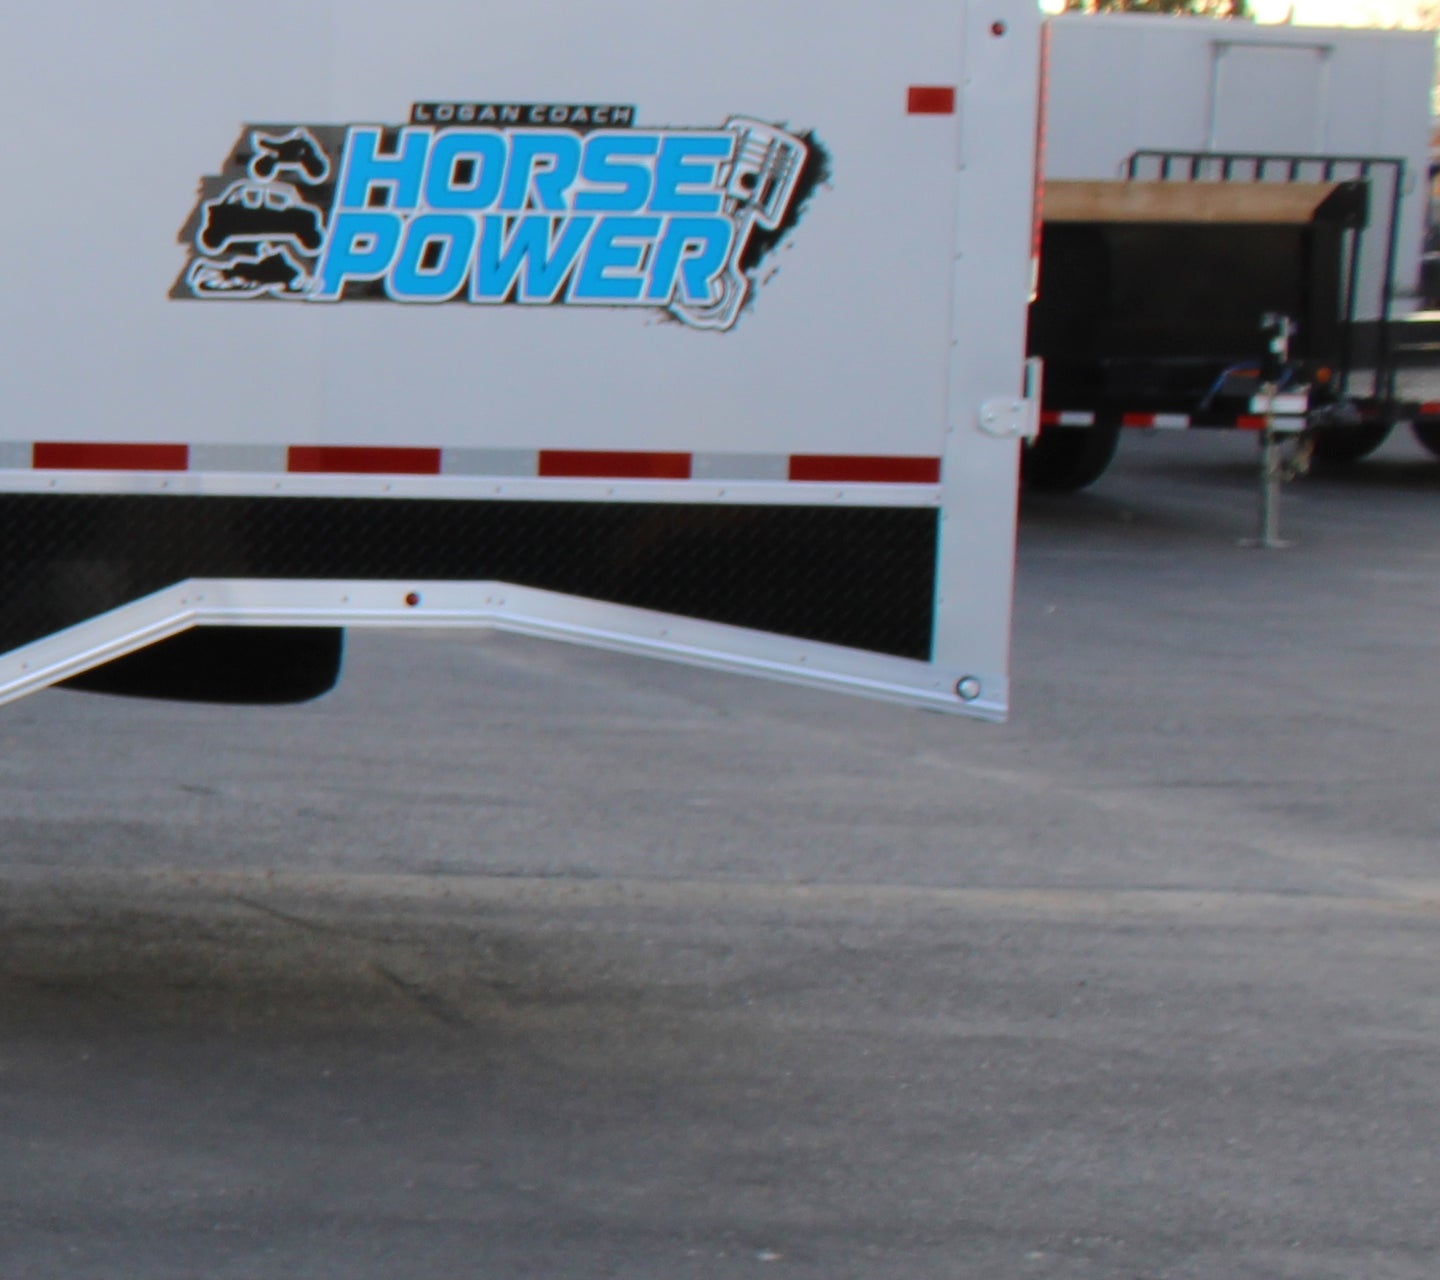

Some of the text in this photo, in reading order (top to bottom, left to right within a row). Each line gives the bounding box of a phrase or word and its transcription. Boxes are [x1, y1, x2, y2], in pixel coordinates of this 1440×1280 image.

[415, 103, 633, 124] LOGAN COACH
[336, 126, 738, 215] HORSE
[312, 211, 733, 302] POWER
